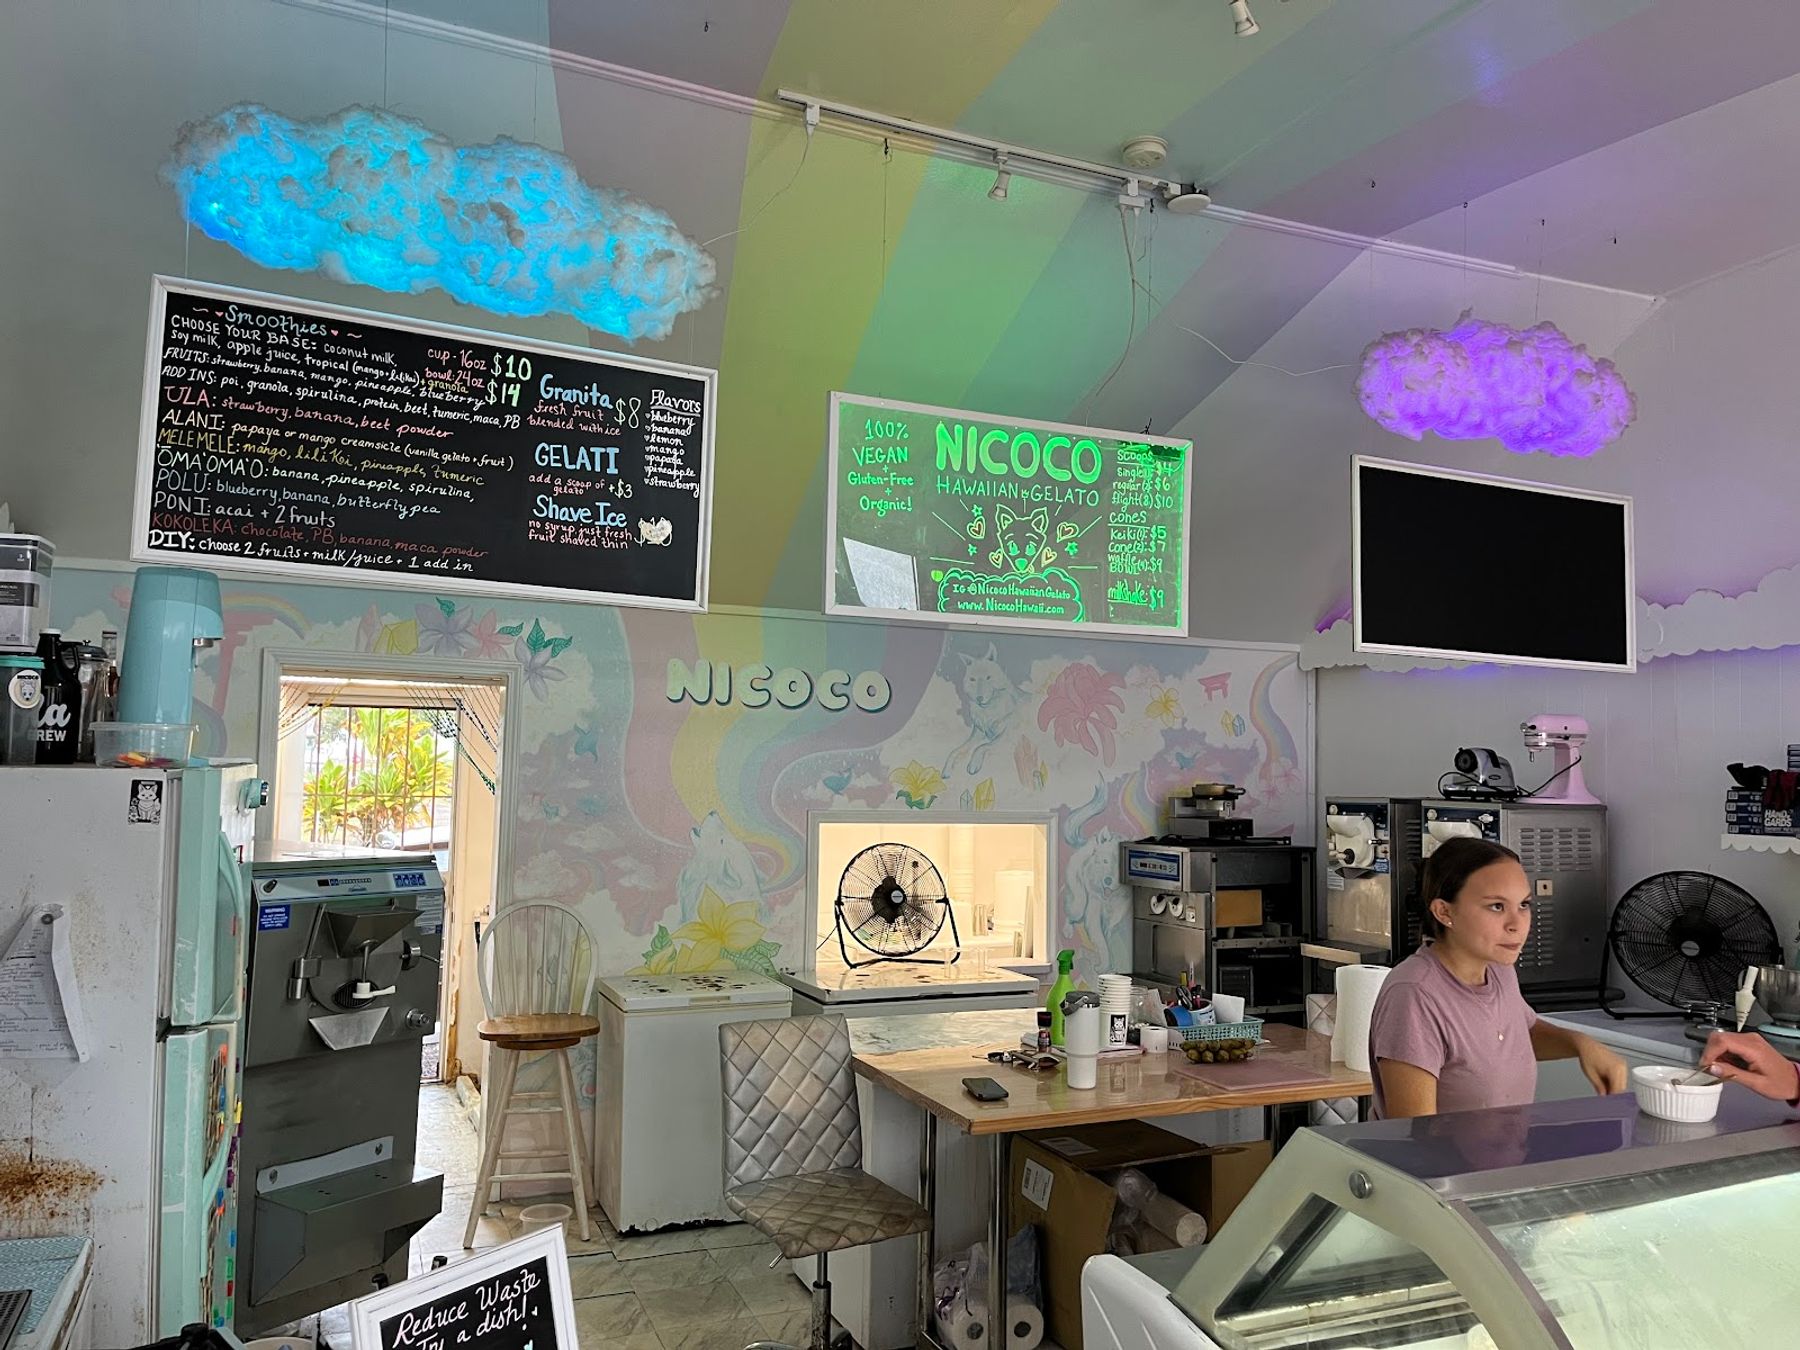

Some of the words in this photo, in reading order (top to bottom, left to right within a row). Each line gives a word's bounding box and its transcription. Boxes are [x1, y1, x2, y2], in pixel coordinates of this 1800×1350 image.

[225, 304, 327, 337] Smoothies
[171, 314, 220, 334] CHOOSE
[225, 324, 260, 340] YOUR
[324, 343, 368, 359] coconut
[227, 341, 262, 355] apple
[304, 353, 349, 372] tropical
[428, 348, 450, 365] cup
[460, 349, 487, 370] 16oz
[491, 352, 532, 381] $10
[427, 380, 469, 394] granola
[455, 370, 485, 388] 24oz
[161, 365, 186, 378] ADD
[187, 368, 217, 385] INS:
[503, 414, 520, 429] PB
[420, 386, 486, 411] blueberry
[485, 379, 520, 407] $14
[540, 374, 613, 409] Granita
[650, 390, 701, 413] Flavors
[534, 400, 567, 416] fresh
[573, 404, 604, 421] fruit
[614, 398, 641, 428] $8
[360, 415, 391, 430] beet
[396, 424, 454, 438] powder
[527, 415, 574, 429] blended
[579, 424, 603, 434] with
[605, 423, 621, 435] ice
[651, 410, 696, 435] blueberry
[651, 423, 687, 436] banana
[865, 419, 908, 440] 100%
[162, 409, 225, 430] ALANI:
[231, 422, 280, 445] papaya
[285, 429, 296, 437] or
[299, 432, 336, 449] mango
[341, 437, 401, 453] creamsicle
[404, 444, 439, 459] (vanilla
[442, 452, 470, 464] gelato
[650, 434, 683, 446] lemon
[535, 443, 619, 474] GELATI
[651, 445, 685, 458] mango
[852, 447, 908, 467] VEGAN
[936, 422, 1102, 484] NICOCO
[156, 468, 212, 493] POLU:
[431, 464, 485, 485] tumeric
[529, 473, 551, 483] add
[567, 479, 591, 490] scoop
[595, 479, 605, 489] of
[648, 464, 696, 479] pineapple
[848, 471, 913, 486] Gluten-Free
[409, 483, 474, 503] spirulina,
[553, 486, 584, 496] gelato
[649, 476, 699, 498] strawberry
[936, 475, 1018, 499] HAWAIIAN
[1031, 485, 1099, 506] GELATO
[1155, 477, 1170, 491] $6
[154, 491, 212, 516] PONI:
[215, 504, 254, 517] acai
[261, 509, 269, 518] +
[275, 505, 286, 523] 2
[289, 505, 335, 527] fruits
[533, 495, 593, 523] Shave
[594, 502, 627, 527] Ice
[860, 495, 912, 517] Organic!
[1154, 492, 1173, 509] $10
[528, 529, 556, 543] fruit
[561, 535, 598, 547] shaved
[601, 538, 628, 549] thin
[529, 520, 541, 528] no
[578, 524, 601, 539] just
[605, 526, 632, 540] fresh
[1150, 525, 1166, 540] $5
[199, 537, 241, 552] choose
[244, 542, 255, 554] 2
[257, 542, 301, 558] fruits
[408, 556, 419, 569] 1
[424, 558, 449, 569] add
[453, 559, 474, 571] in
[394, 541, 438, 554] maca
[442, 546, 488, 558] powder
[1149, 540, 1165, 553] $7
[1150, 556, 1162, 573] $9
[1149, 586, 1164, 611] $9
[666, 658, 892, 713] NICOCO
[392, 1301, 469, 1349] Reduce
[475, 1269, 541, 1310] Waste
[457, 1330, 472, 1344] a
[476, 1294, 527, 1337] dish!
